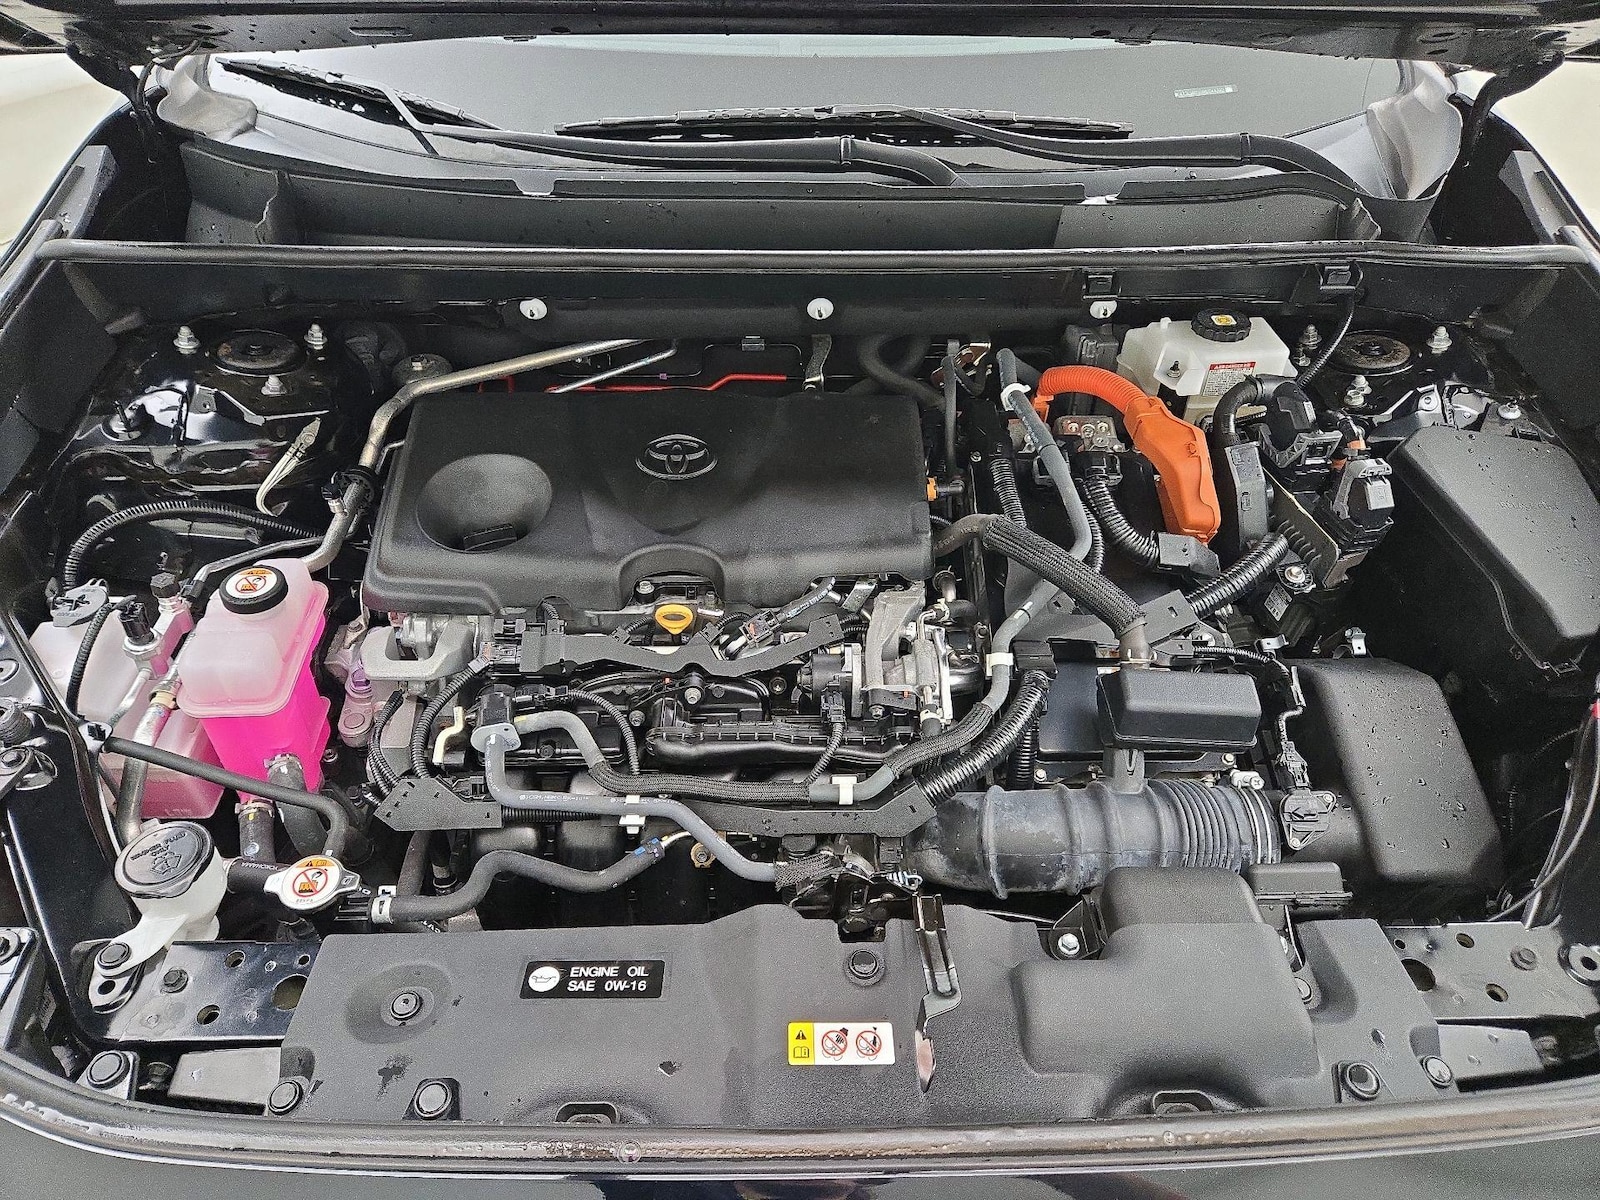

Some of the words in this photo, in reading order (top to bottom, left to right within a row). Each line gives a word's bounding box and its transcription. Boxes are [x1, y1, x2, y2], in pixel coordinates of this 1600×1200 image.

[570, 966, 619, 978] ENGINE
[627, 966, 650, 978] OIL
[567, 980, 596, 992] SAE
[604, 980, 648, 992] 0W-16
